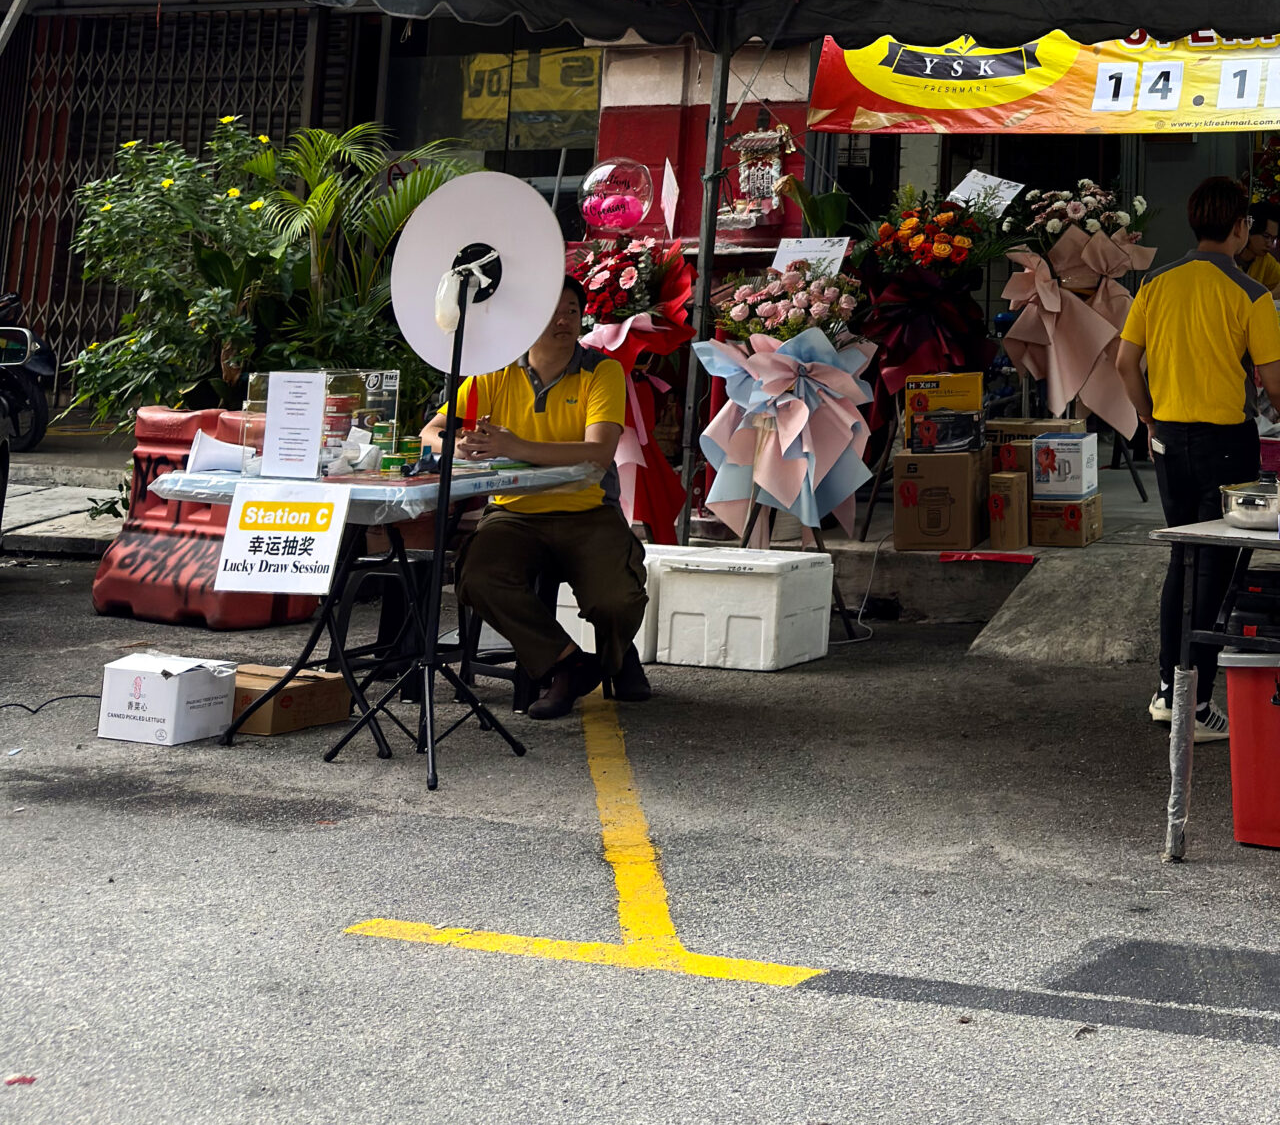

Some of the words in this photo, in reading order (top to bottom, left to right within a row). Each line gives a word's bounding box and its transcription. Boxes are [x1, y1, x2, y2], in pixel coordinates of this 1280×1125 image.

[922, 57, 997, 77] YSK
[923, 84, 988, 93] FRESHMART
[244, 506, 310, 525] Station
[316, 507, 329, 525] C
[248, 535, 316, 557] 幸运抽奖
[222, 558, 256, 576] Lucky
[258, 559, 289, 574] Draw
[290, 560, 330, 574] Session
[107, 712, 126, 720] CANNED
[126, 714, 145, 722] PICKLED
[145, 716, 166, 724] LETTUCE
